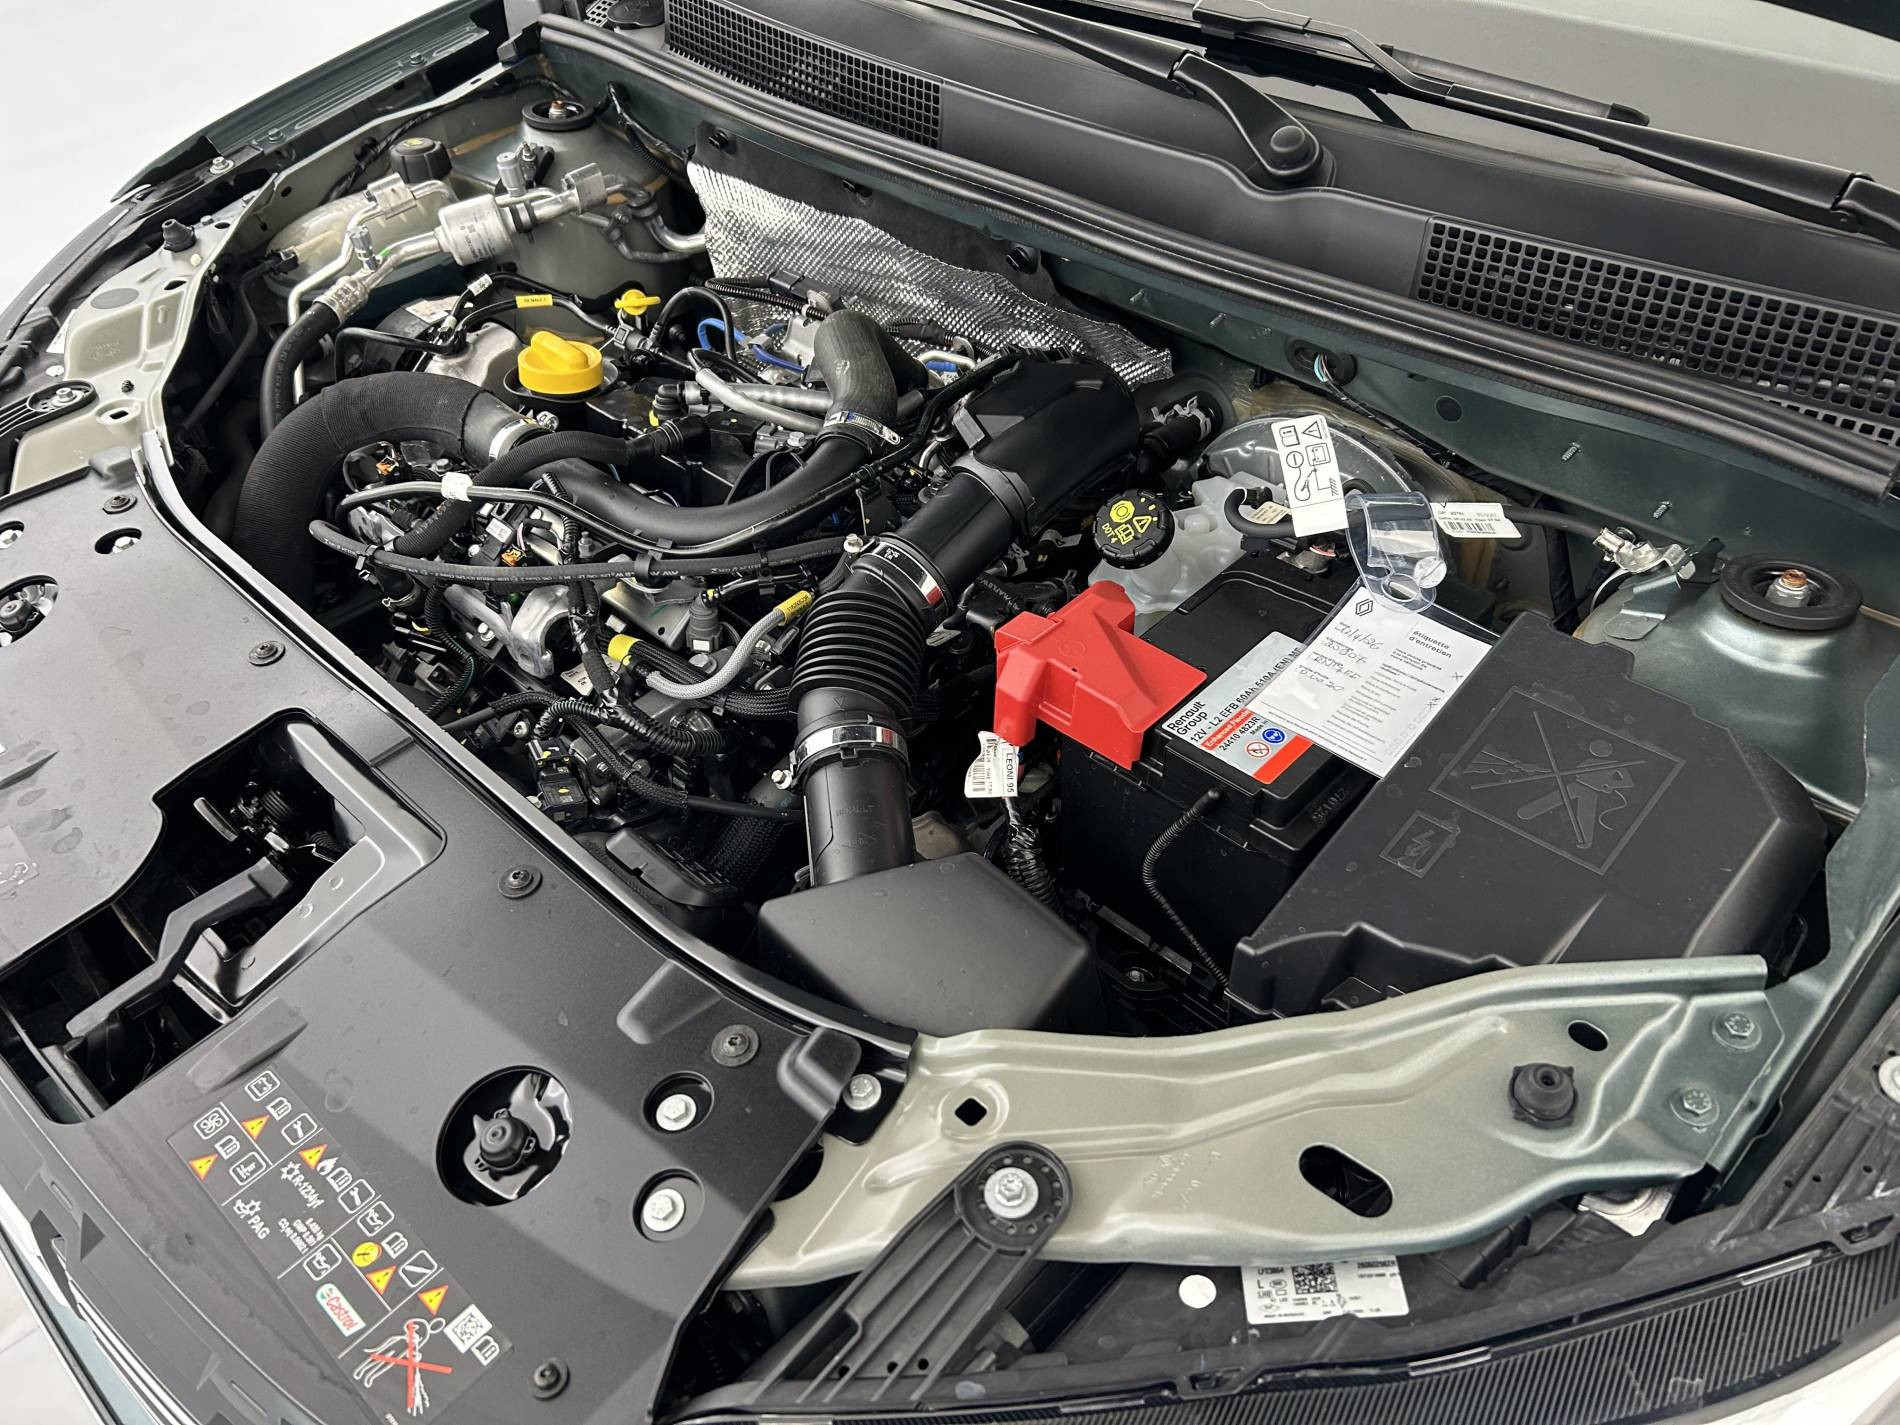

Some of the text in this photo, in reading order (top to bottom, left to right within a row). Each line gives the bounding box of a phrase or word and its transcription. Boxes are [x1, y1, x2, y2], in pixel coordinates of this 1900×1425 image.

[1102, 523, 1115, 537] DOT
[1408, 636, 1452, 658] d'entretien
[1413, 630, 1450, 649] étiquette
[1190, 727, 1207, 743] 12V
[1210, 714, 1222, 727] L2
[1220, 702, 1239, 718] EFB
[1236, 686, 1257, 704] 60Ah
[1255, 671, 1275, 688] 510A
[1273, 656, 1292, 674] (EN)
[1167, 701, 1206, 731] Renault
[1176, 710, 1208, 736] Group
[1205, 723, 1233, 748] Enhanced
[1250, 723, 1264, 735] Made
[1218, 733, 1241, 751] 24410
[1006, 752, 1014, 793] LEONI 95
[247, 1214, 271, 1240] PAG
[326, 1293, 360, 1331] Castrol
